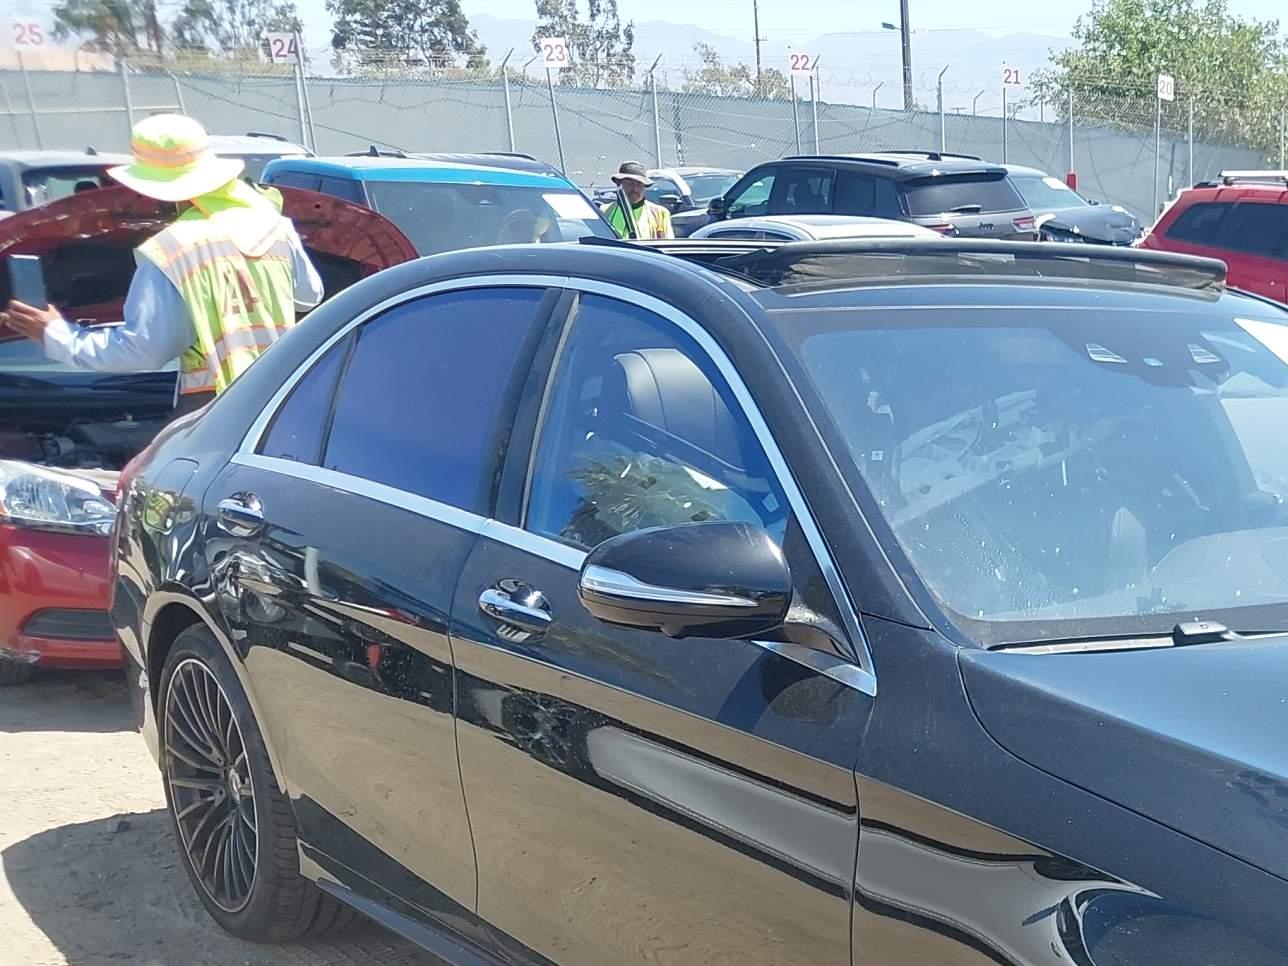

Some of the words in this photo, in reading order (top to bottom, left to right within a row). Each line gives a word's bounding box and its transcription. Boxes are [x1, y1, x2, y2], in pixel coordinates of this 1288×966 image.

[12, 22, 44, 46] 25
[273, 38, 299, 58] 24
[544, 44, 566, 62] 23
[790, 54, 811, 70] 22
[1003, 68, 1021, 84] 21
[1159, 79, 1173, 96] 20
